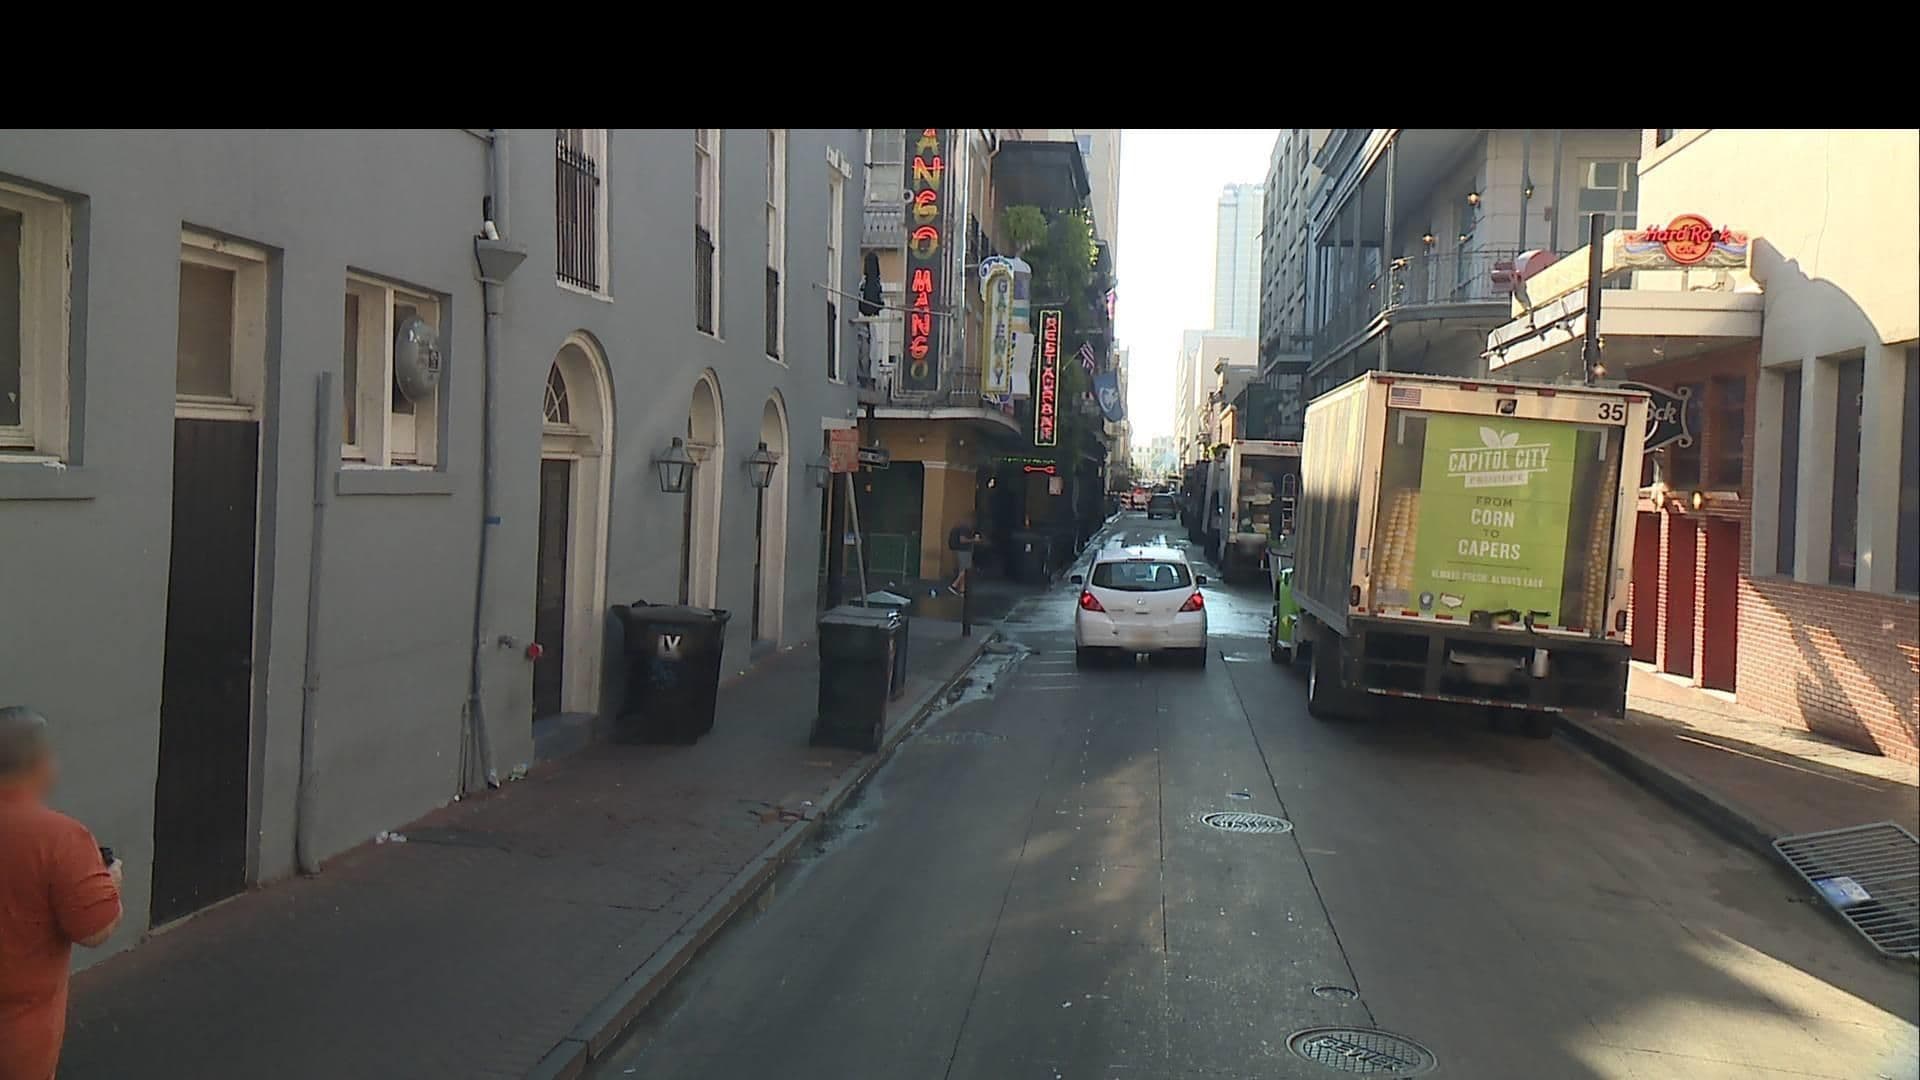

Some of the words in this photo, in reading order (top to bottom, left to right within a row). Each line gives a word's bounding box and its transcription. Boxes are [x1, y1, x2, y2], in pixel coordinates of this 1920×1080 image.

[912, 131, 943, 259] ANGO
[1646, 224, 1689, 242] Hard
[911, 269, 932, 380] MANGO
[1041, 317, 1057, 440] RESTAURANT
[1598, 403, 1624, 421] 35
[1647, 401, 1677, 424] ock
[1448, 451, 1510, 472] CAPITOL
[1515, 446, 1549, 468] CITY
[1476, 496, 1513, 507] FROM
[1471, 508, 1515, 527] CORN
[1482, 529, 1500, 539] TO
[1458, 539, 1521, 560] CAPERS
